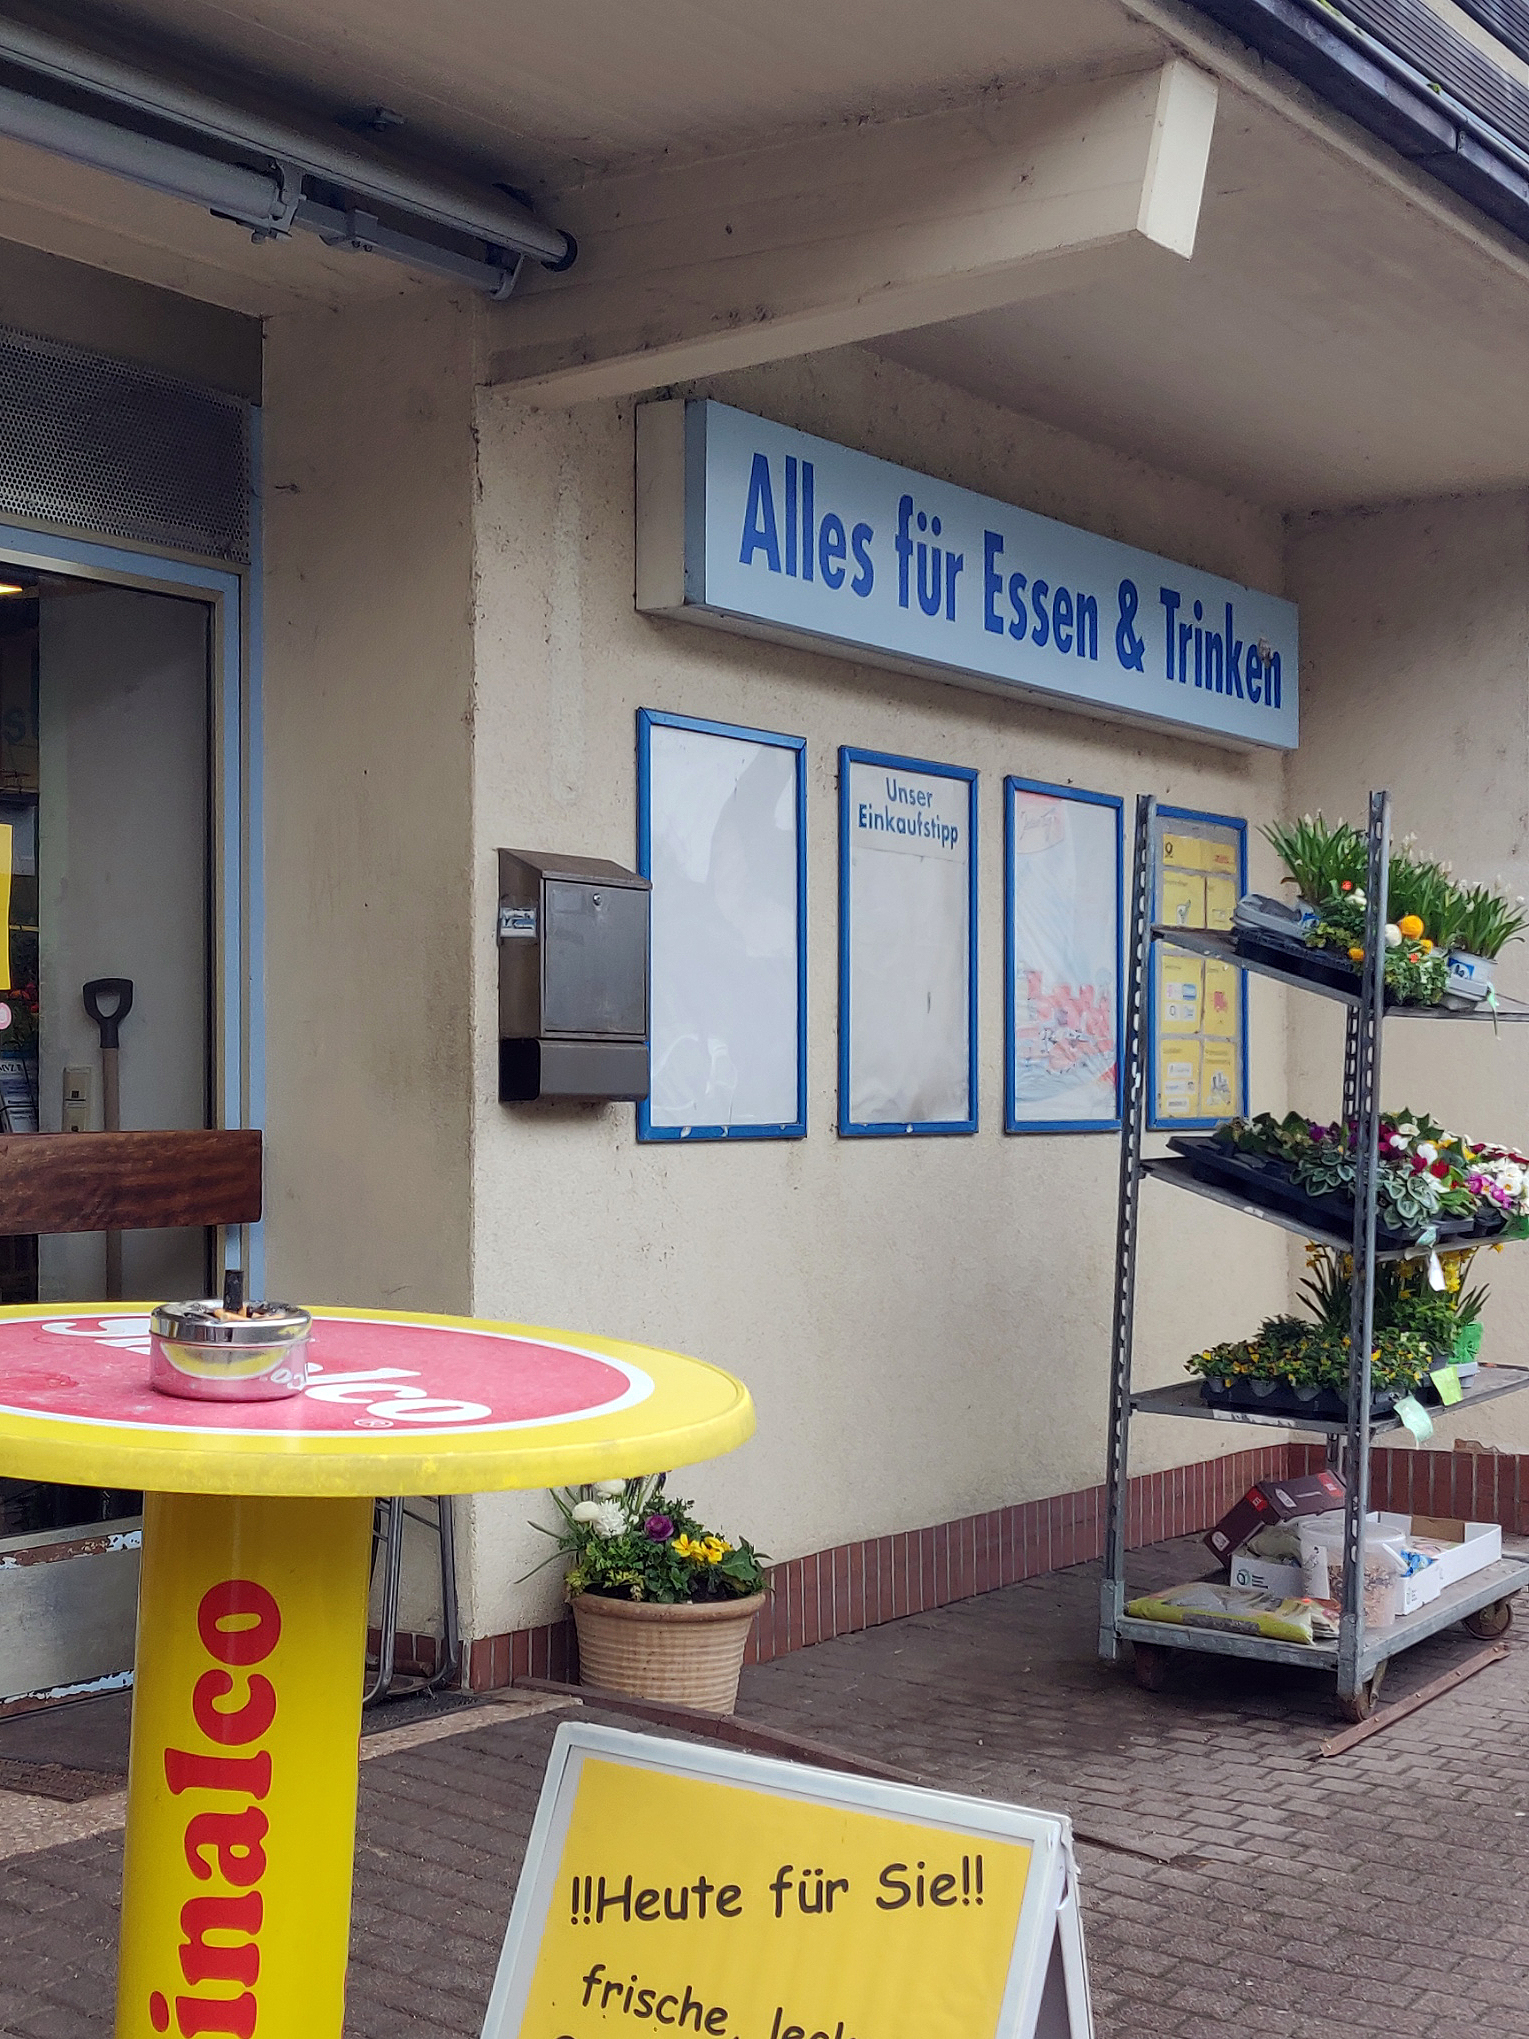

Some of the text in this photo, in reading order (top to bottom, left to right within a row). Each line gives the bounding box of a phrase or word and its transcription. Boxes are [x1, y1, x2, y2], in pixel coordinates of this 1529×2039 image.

[740, 452, 1283, 710] Alles für Essen & Trinken
[858, 803, 958, 850] Einkaufstipp
[886, 777, 933, 808] Unser
[570, 1854, 985, 1925] !!Heute für Sie!!
[582, 1964, 739, 2039] frische
